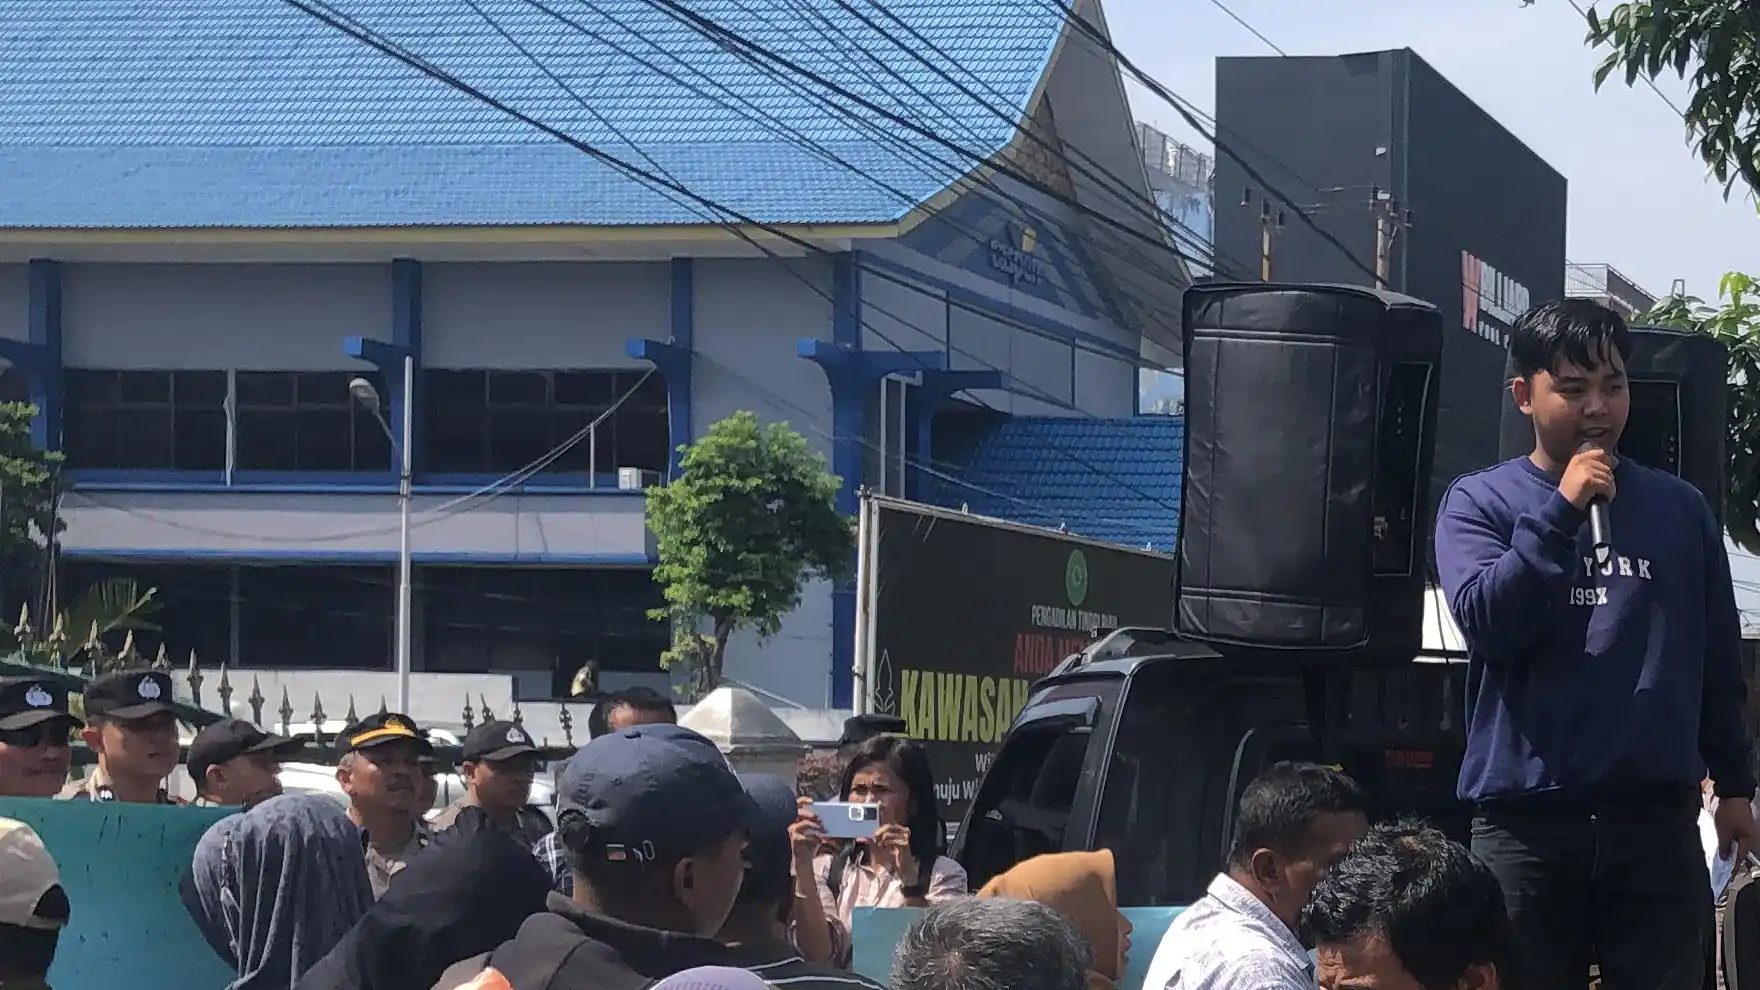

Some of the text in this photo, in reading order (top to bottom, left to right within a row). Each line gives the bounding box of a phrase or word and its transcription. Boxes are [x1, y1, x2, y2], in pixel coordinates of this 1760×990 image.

[1569, 586, 1608, 606] 199X
[1031, 604, 1077, 630] PENGADILAN
[934, 777, 960, 806] nuju
